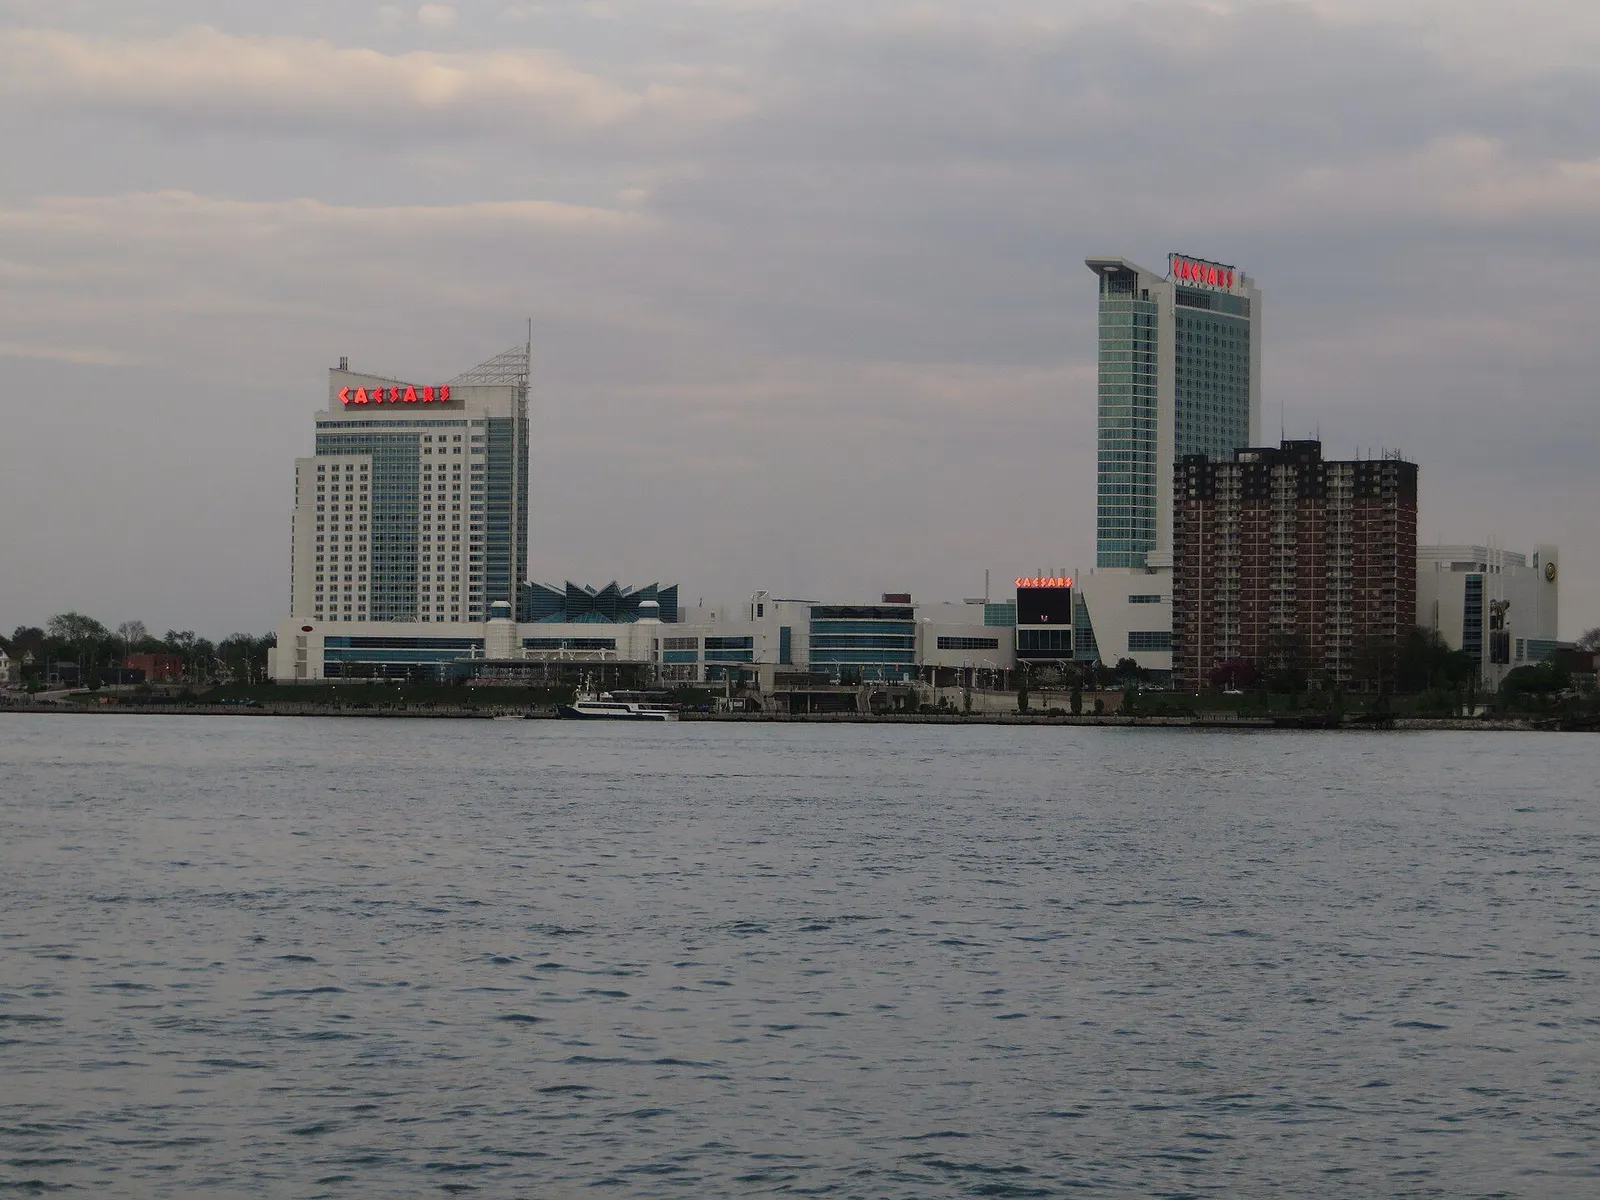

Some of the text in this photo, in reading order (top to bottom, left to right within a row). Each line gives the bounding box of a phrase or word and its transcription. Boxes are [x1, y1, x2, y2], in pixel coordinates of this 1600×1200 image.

[1173, 258, 1233, 287] CAESARS
[338, 384, 450, 404] CAESARS
[1015, 577, 1073, 587] CAESARS
